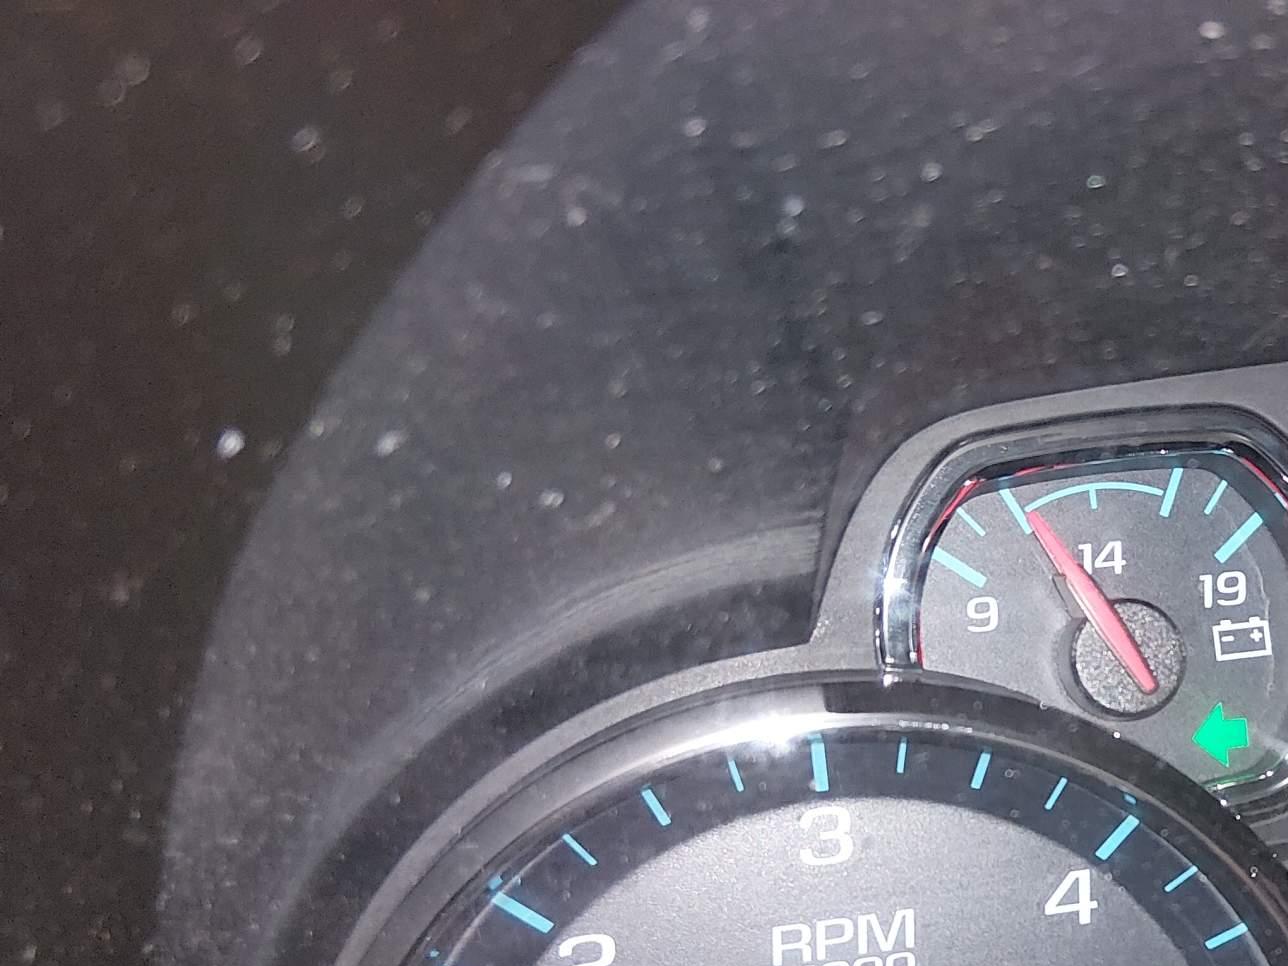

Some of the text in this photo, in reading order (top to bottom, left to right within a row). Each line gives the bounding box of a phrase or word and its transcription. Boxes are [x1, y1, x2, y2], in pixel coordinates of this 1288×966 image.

[1078, 541, 1126, 575] 14
[1199, 571, 1247, 608] 19
[966, 596, 999, 633] 9
[799, 805, 853, 866] 3
[1043, 869, 1099, 926] 4
[771, 908, 915, 966] RPM
